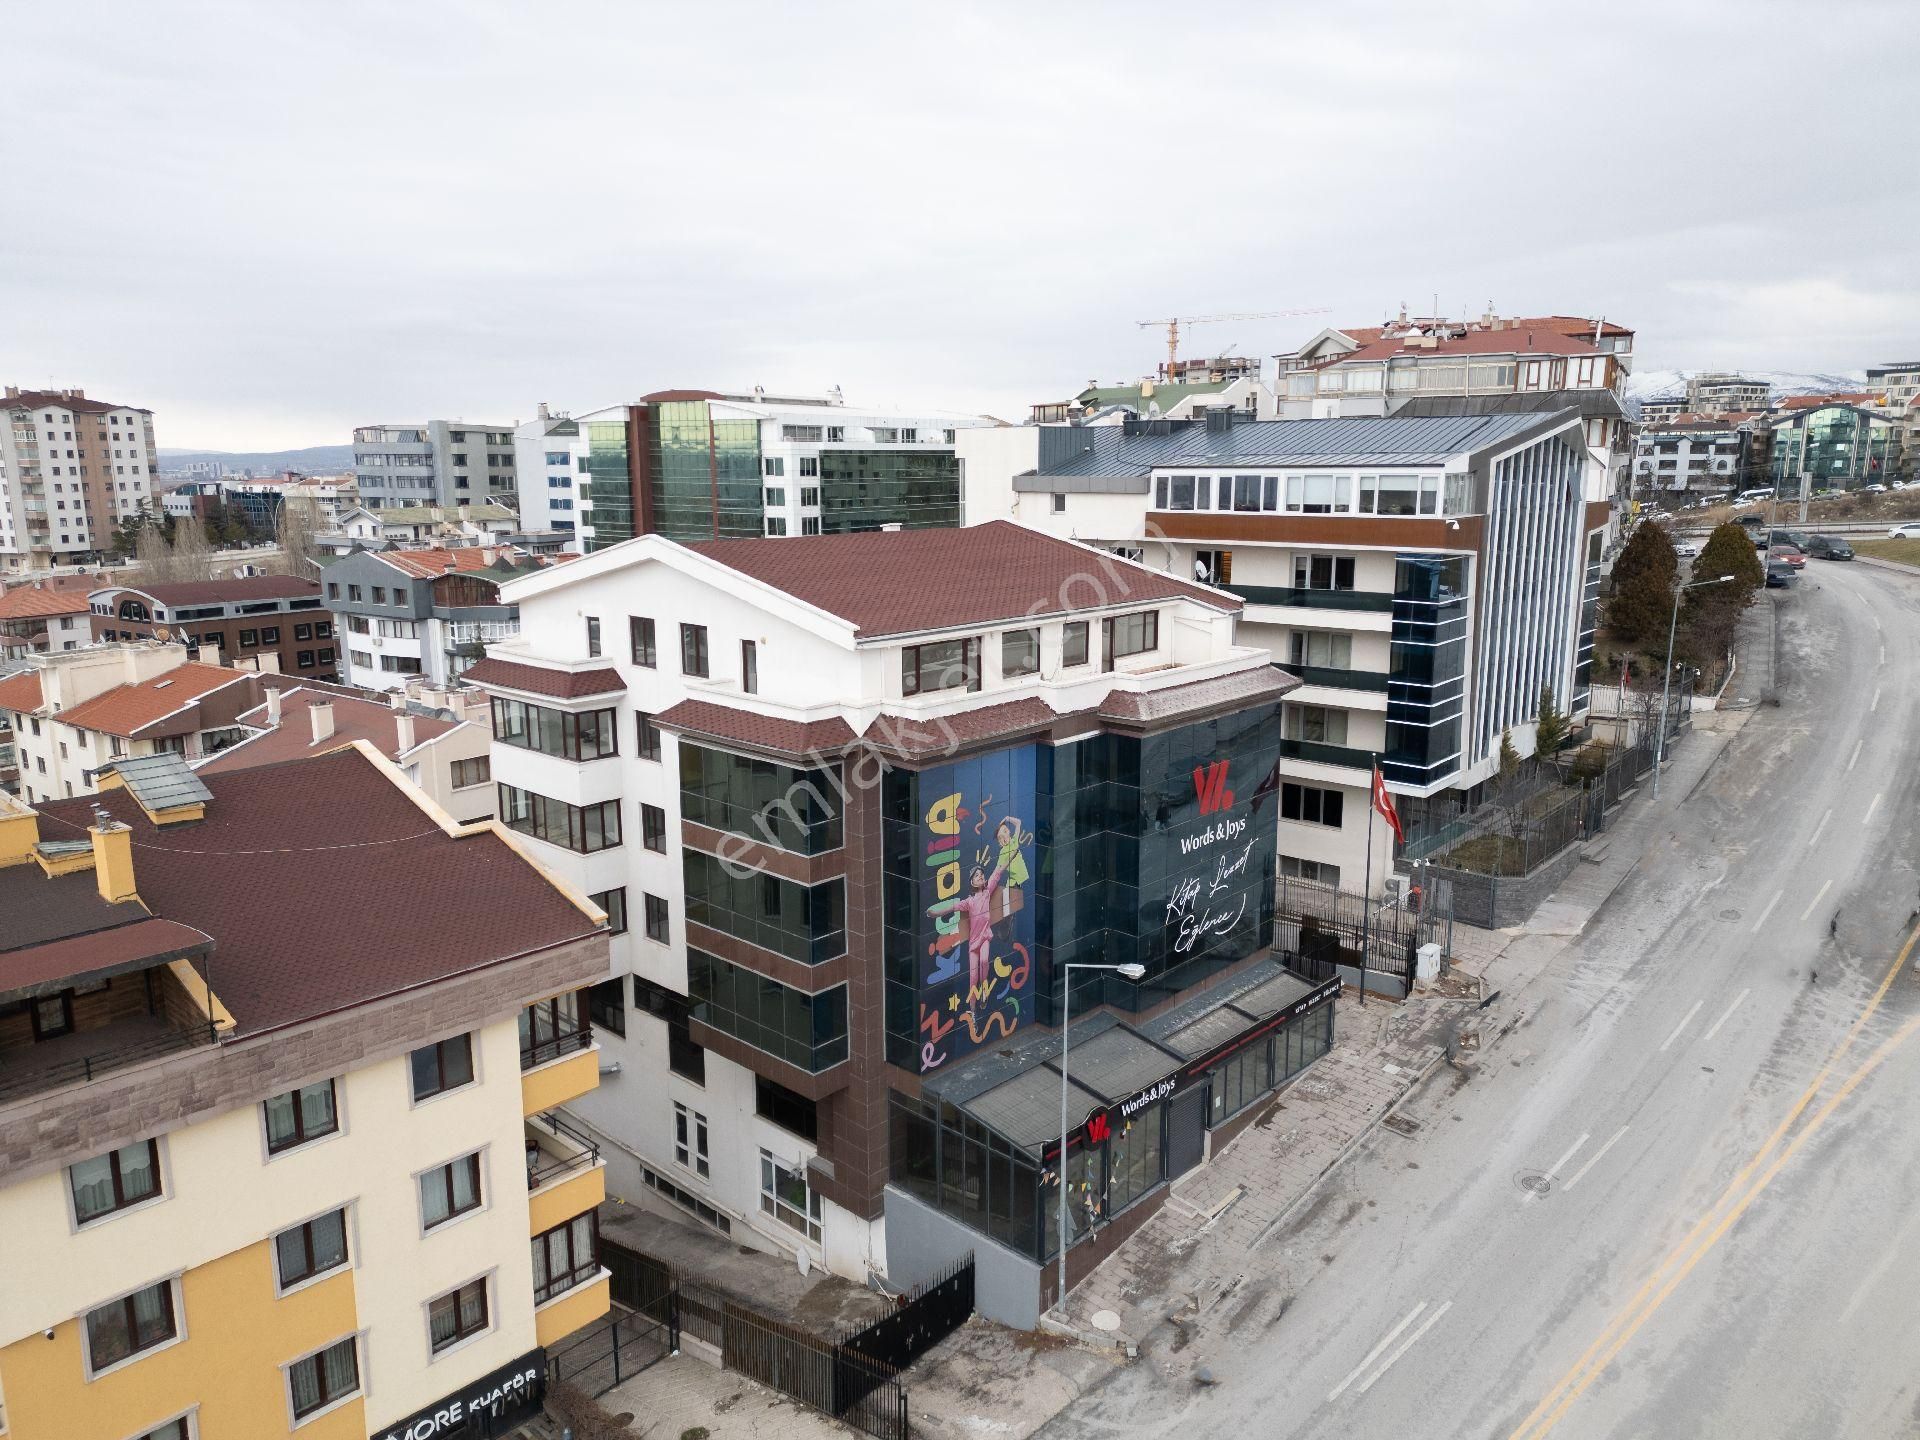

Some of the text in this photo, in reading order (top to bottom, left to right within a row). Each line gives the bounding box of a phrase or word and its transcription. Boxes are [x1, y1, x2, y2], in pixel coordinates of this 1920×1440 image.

[1180, 826, 1215, 855] Words
[1225, 817, 1246, 841] Joys
[925, 792, 962, 984] kidolia
[1208, 837, 1260, 898] Lezzet
[1174, 908, 1237, 953] Eğlence
[469, 1368, 536, 1413] KUAFÖR
